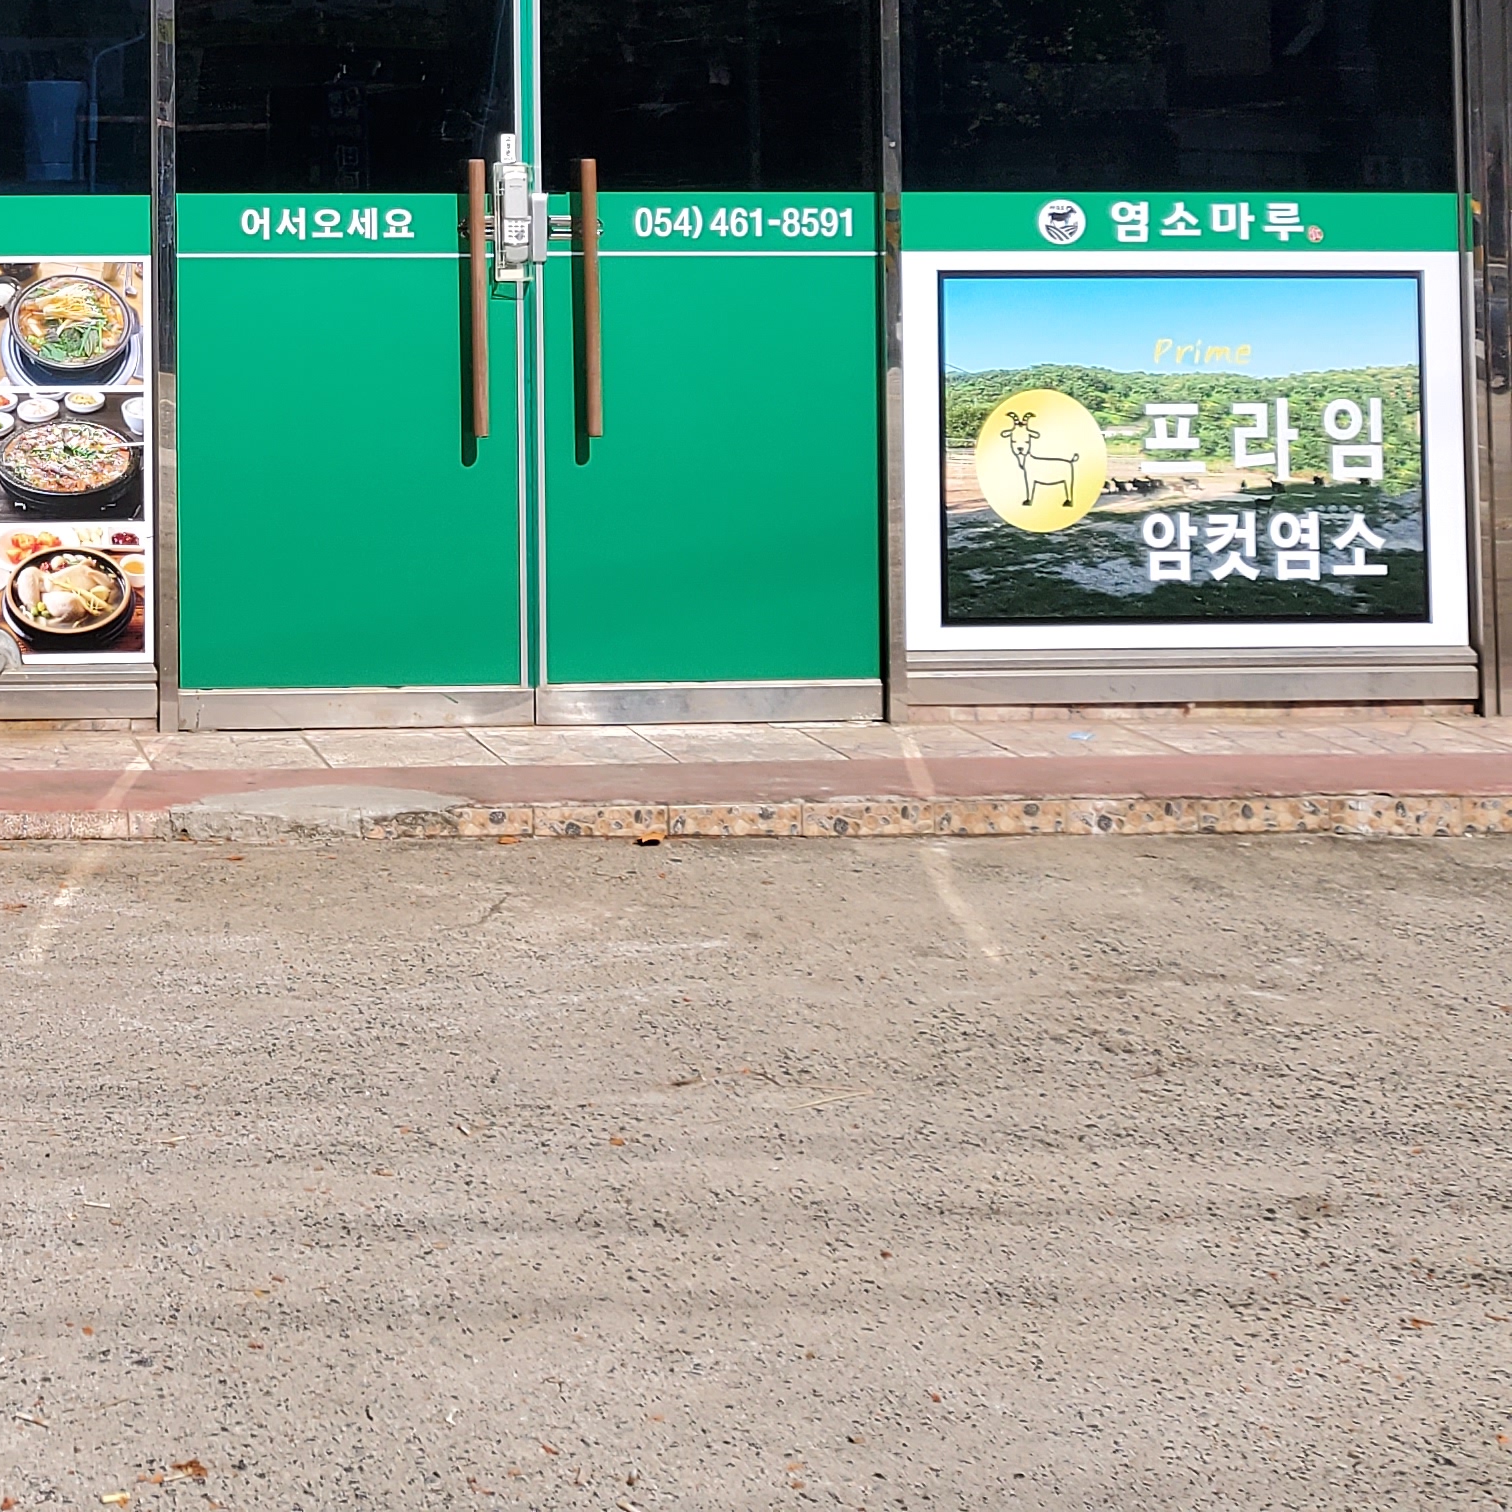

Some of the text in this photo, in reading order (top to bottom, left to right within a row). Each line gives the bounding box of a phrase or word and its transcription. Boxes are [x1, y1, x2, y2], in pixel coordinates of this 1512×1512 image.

[240, 205, 415, 243] 어서오세요
[635, 205, 855, 240] 054) 461-8591
[1111, 201, 1305, 243] 염소마루
[1152, 337, 1252, 366] Prime
[1140, 395, 1385, 484] 프라임
[1141, 511, 1388, 581] 암컷염소
